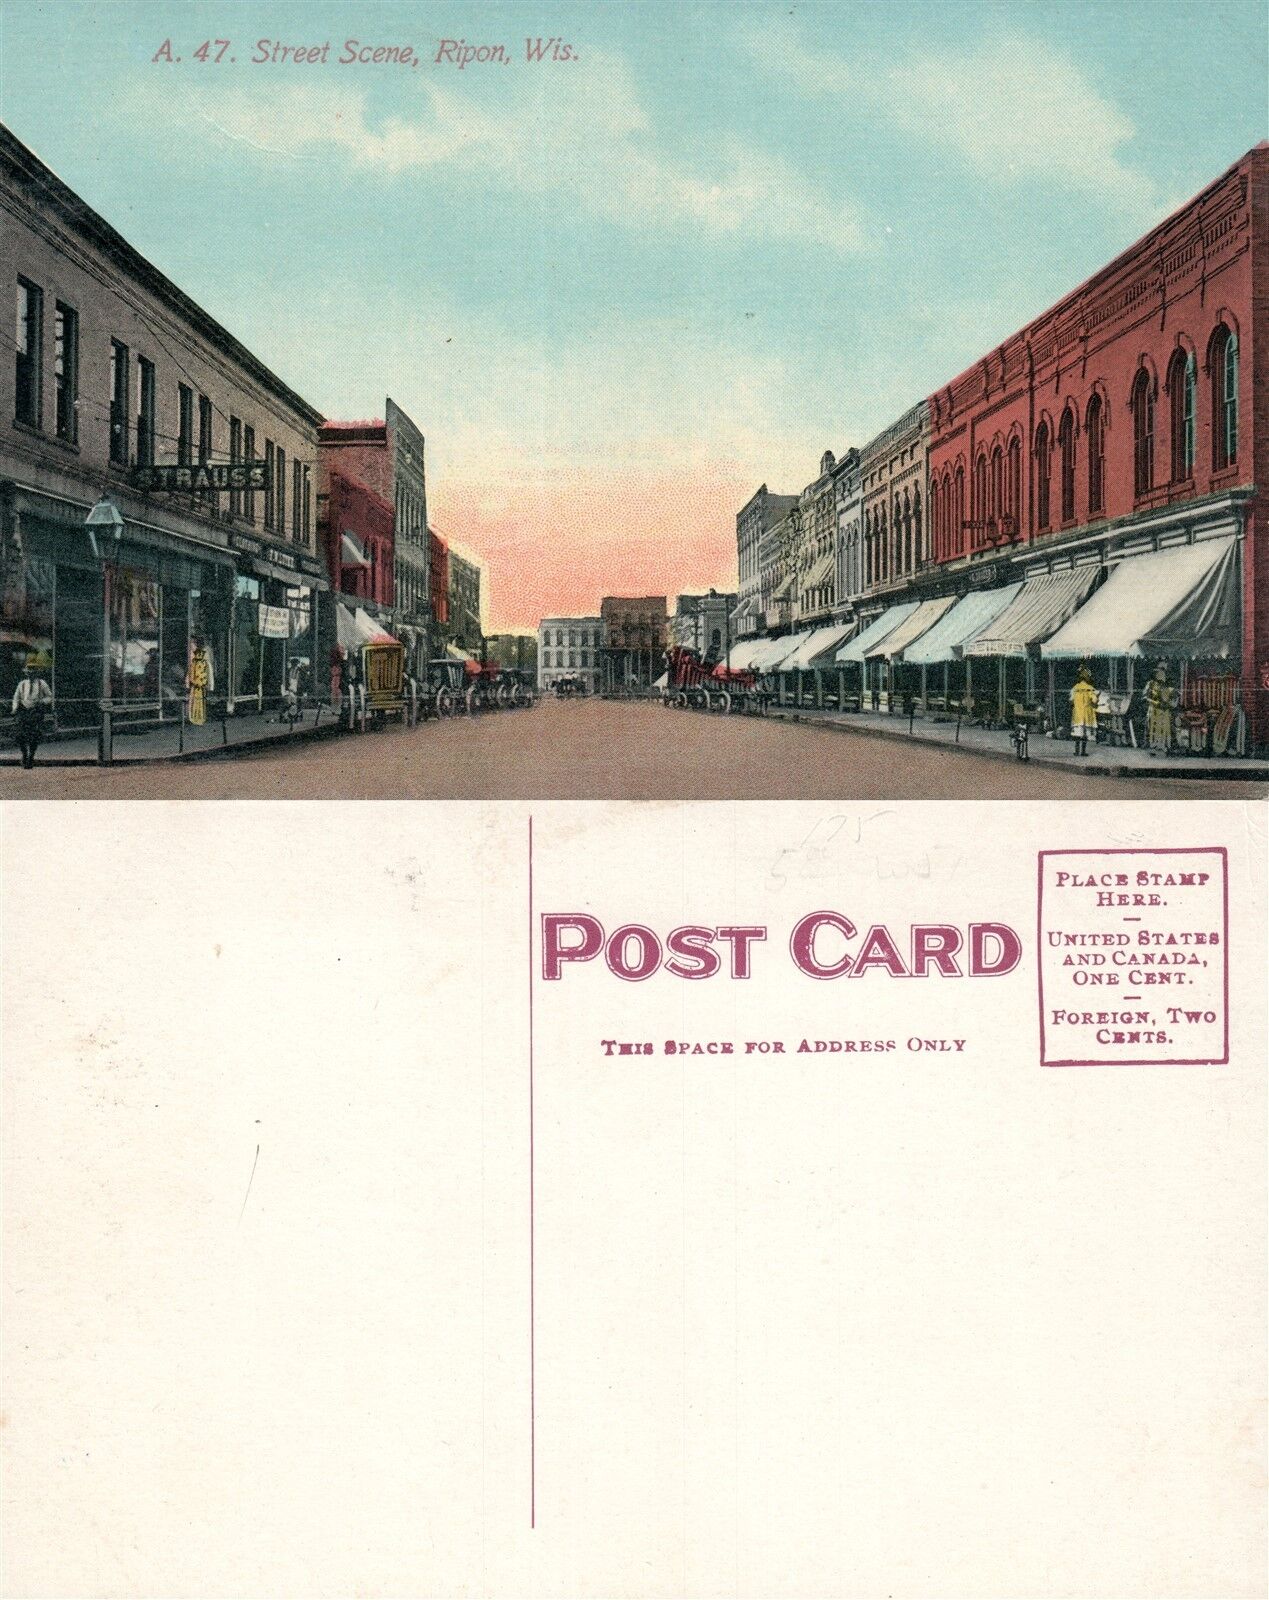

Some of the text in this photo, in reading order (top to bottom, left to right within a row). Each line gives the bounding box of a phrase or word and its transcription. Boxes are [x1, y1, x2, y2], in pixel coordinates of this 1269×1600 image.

[136, 467, 264, 488] STRAUSS
[1056, 870, 1212, 888] PLACE STAMP
[1096, 891, 1169, 908] HERE.
[540, 909, 1024, 983] POST CARD
[1048, 929, 1220, 947] UNITED STATES
[1072, 970, 1121, 987] ONE
